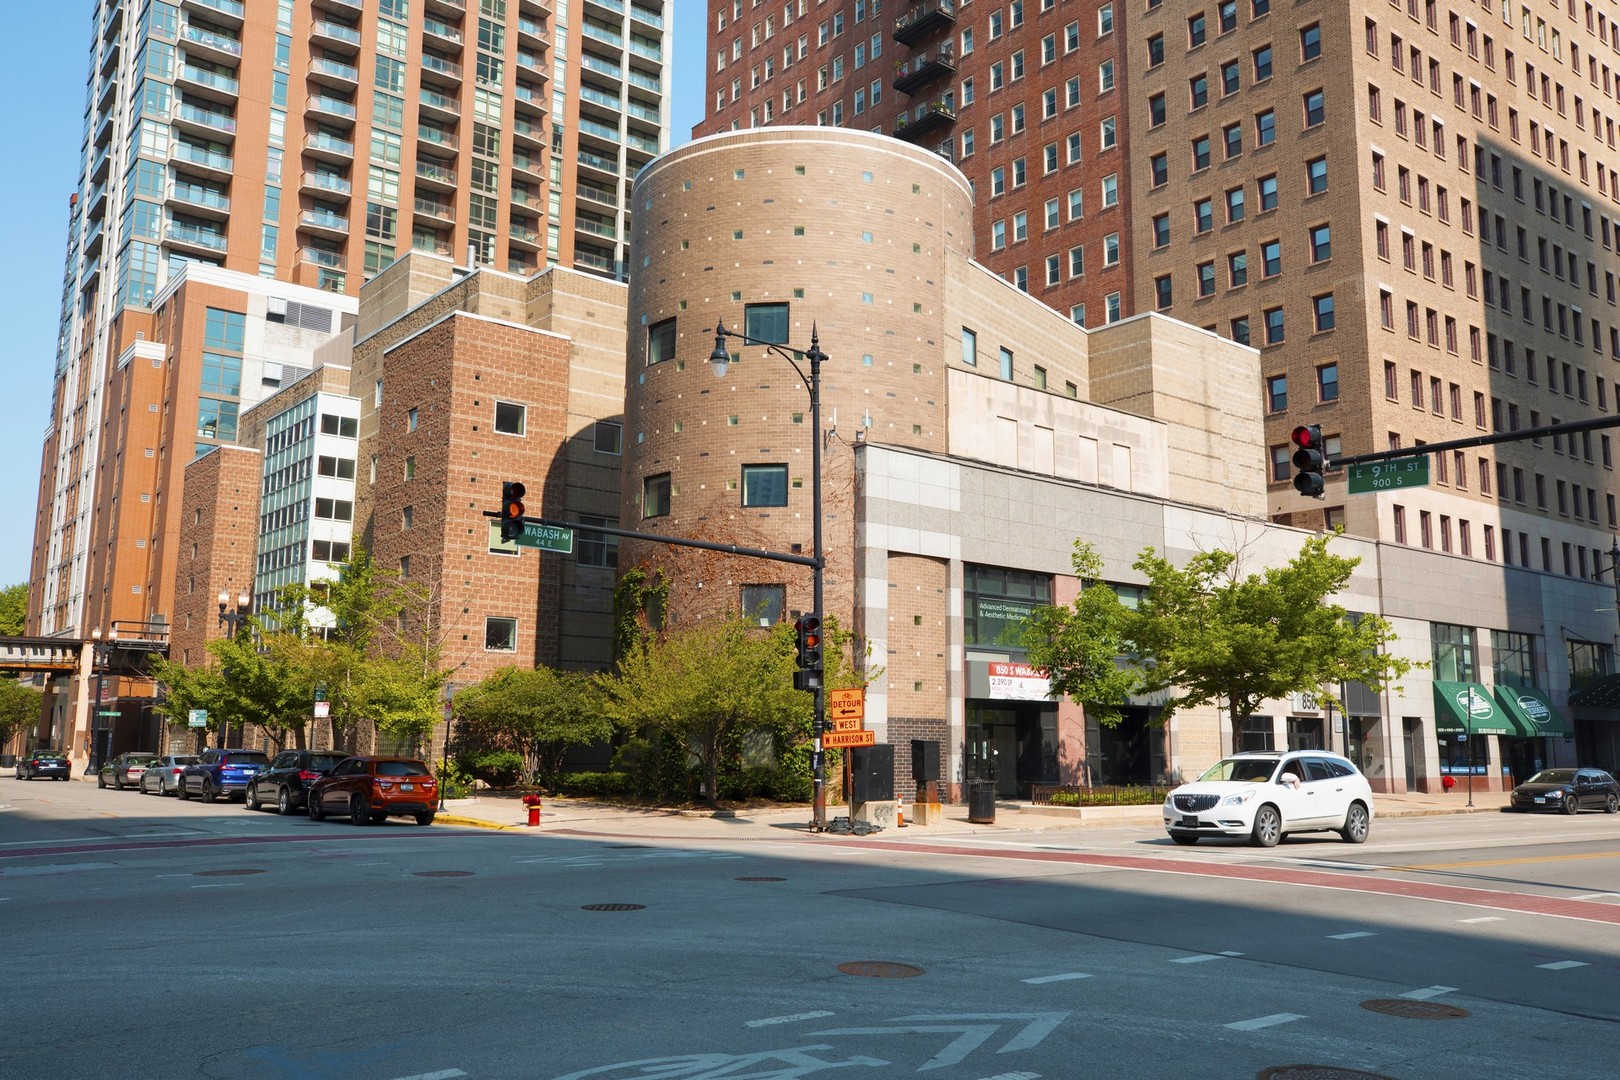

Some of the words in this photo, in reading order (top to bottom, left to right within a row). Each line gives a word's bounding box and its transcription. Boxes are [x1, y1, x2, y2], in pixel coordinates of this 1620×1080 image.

[1357, 470, 1362, 478] E
[1372, 464, 1397, 477] 9TH
[1407, 462, 1418, 471] ST
[1372, 478, 1391, 487] 900
[525, 527, 560, 539] WABASH
[980, 602, 1002, 611] Advanced
[1003, 604, 1031, 615] Dermatology
[985, 611, 1006, 619] Aesthetic
[996, 666, 1008, 675] 850
[1009, 666, 1014, 675] S
[833, 700, 861, 708] DETOUR
[1302, 694, 1316, 710] 850
[839, 721, 856, 729] WEST
[833, 735, 863, 744] HARRISON
[866, 734, 873, 742] ST
